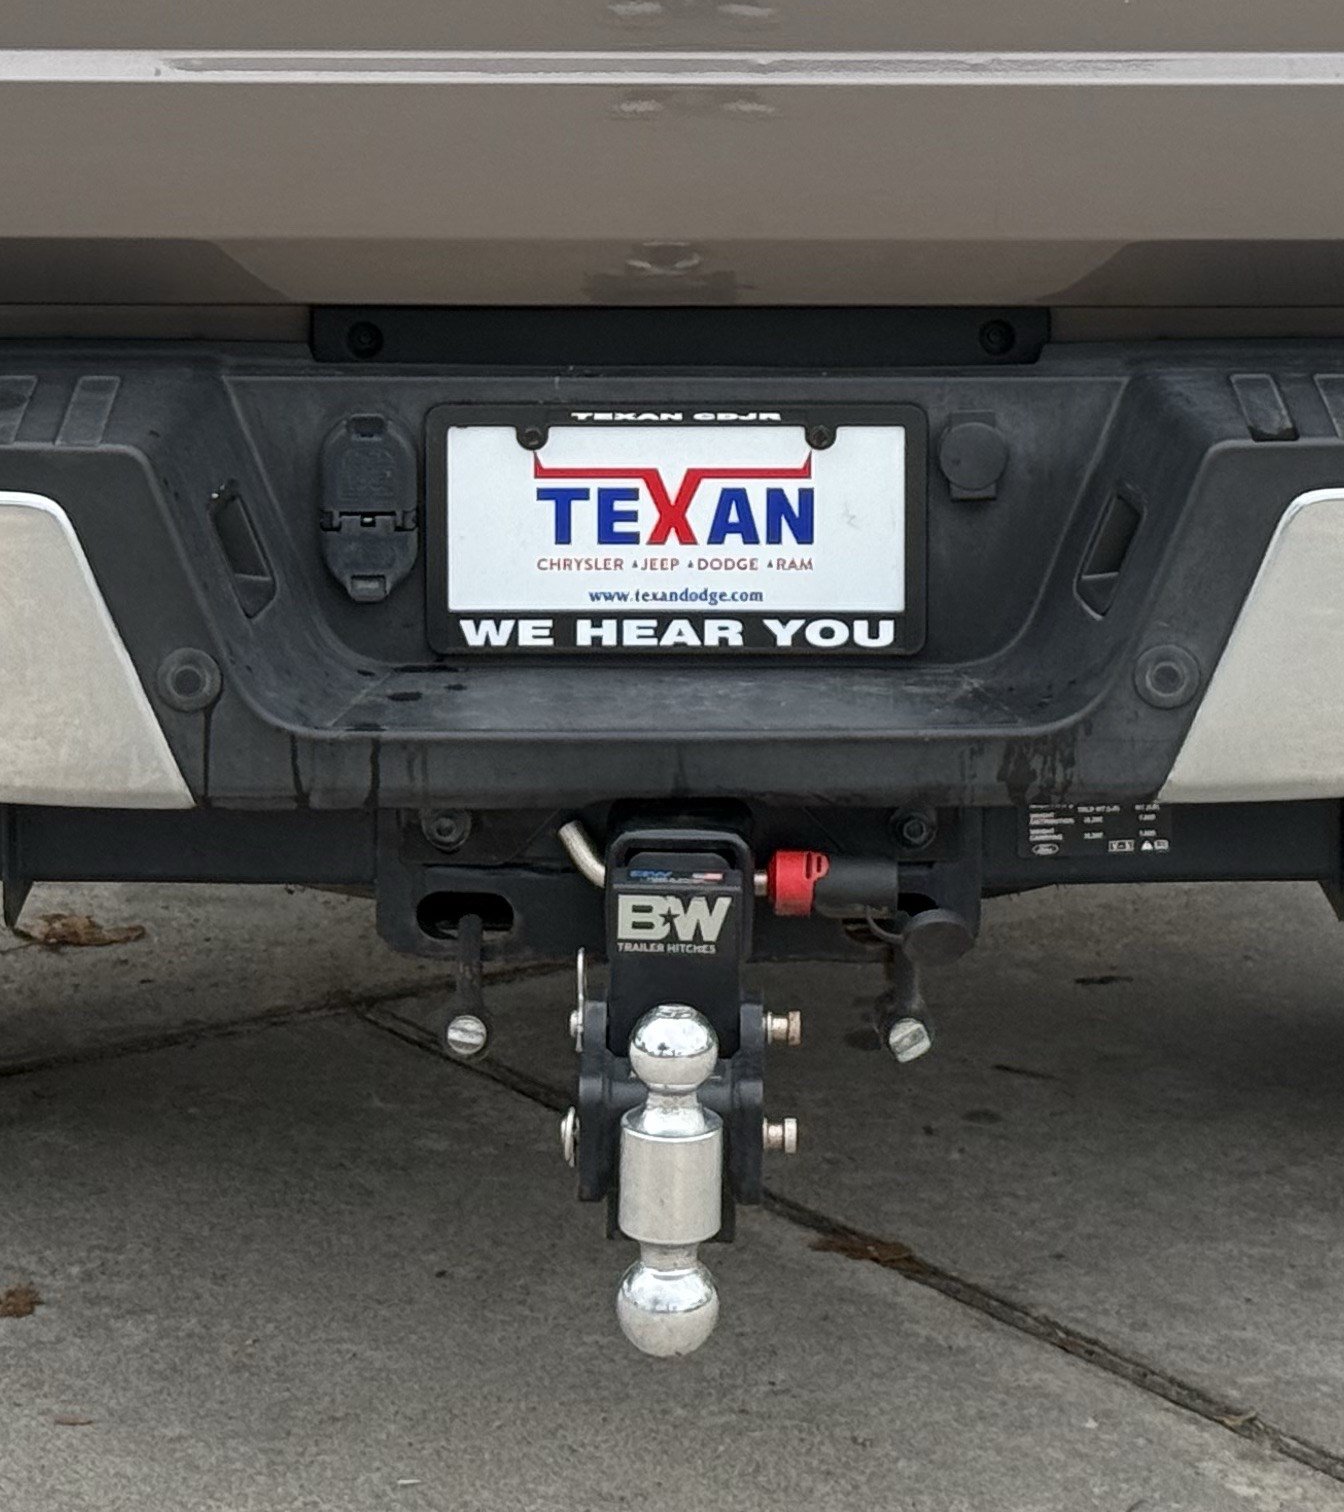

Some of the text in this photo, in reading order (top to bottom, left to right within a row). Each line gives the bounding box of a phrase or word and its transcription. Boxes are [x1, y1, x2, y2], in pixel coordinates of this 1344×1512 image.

[570, 411, 782, 421] TEXAN CDJR
[535, 468, 815, 546] TEXAN
[536, 557, 814, 572] CHRYSLER JEEP DODGE RAM
[588, 587, 764, 606] www.texandodge.com
[459, 619, 896, 648] WE HEAR YOU
[617, 942, 716, 954] TRAILER HITCHES
